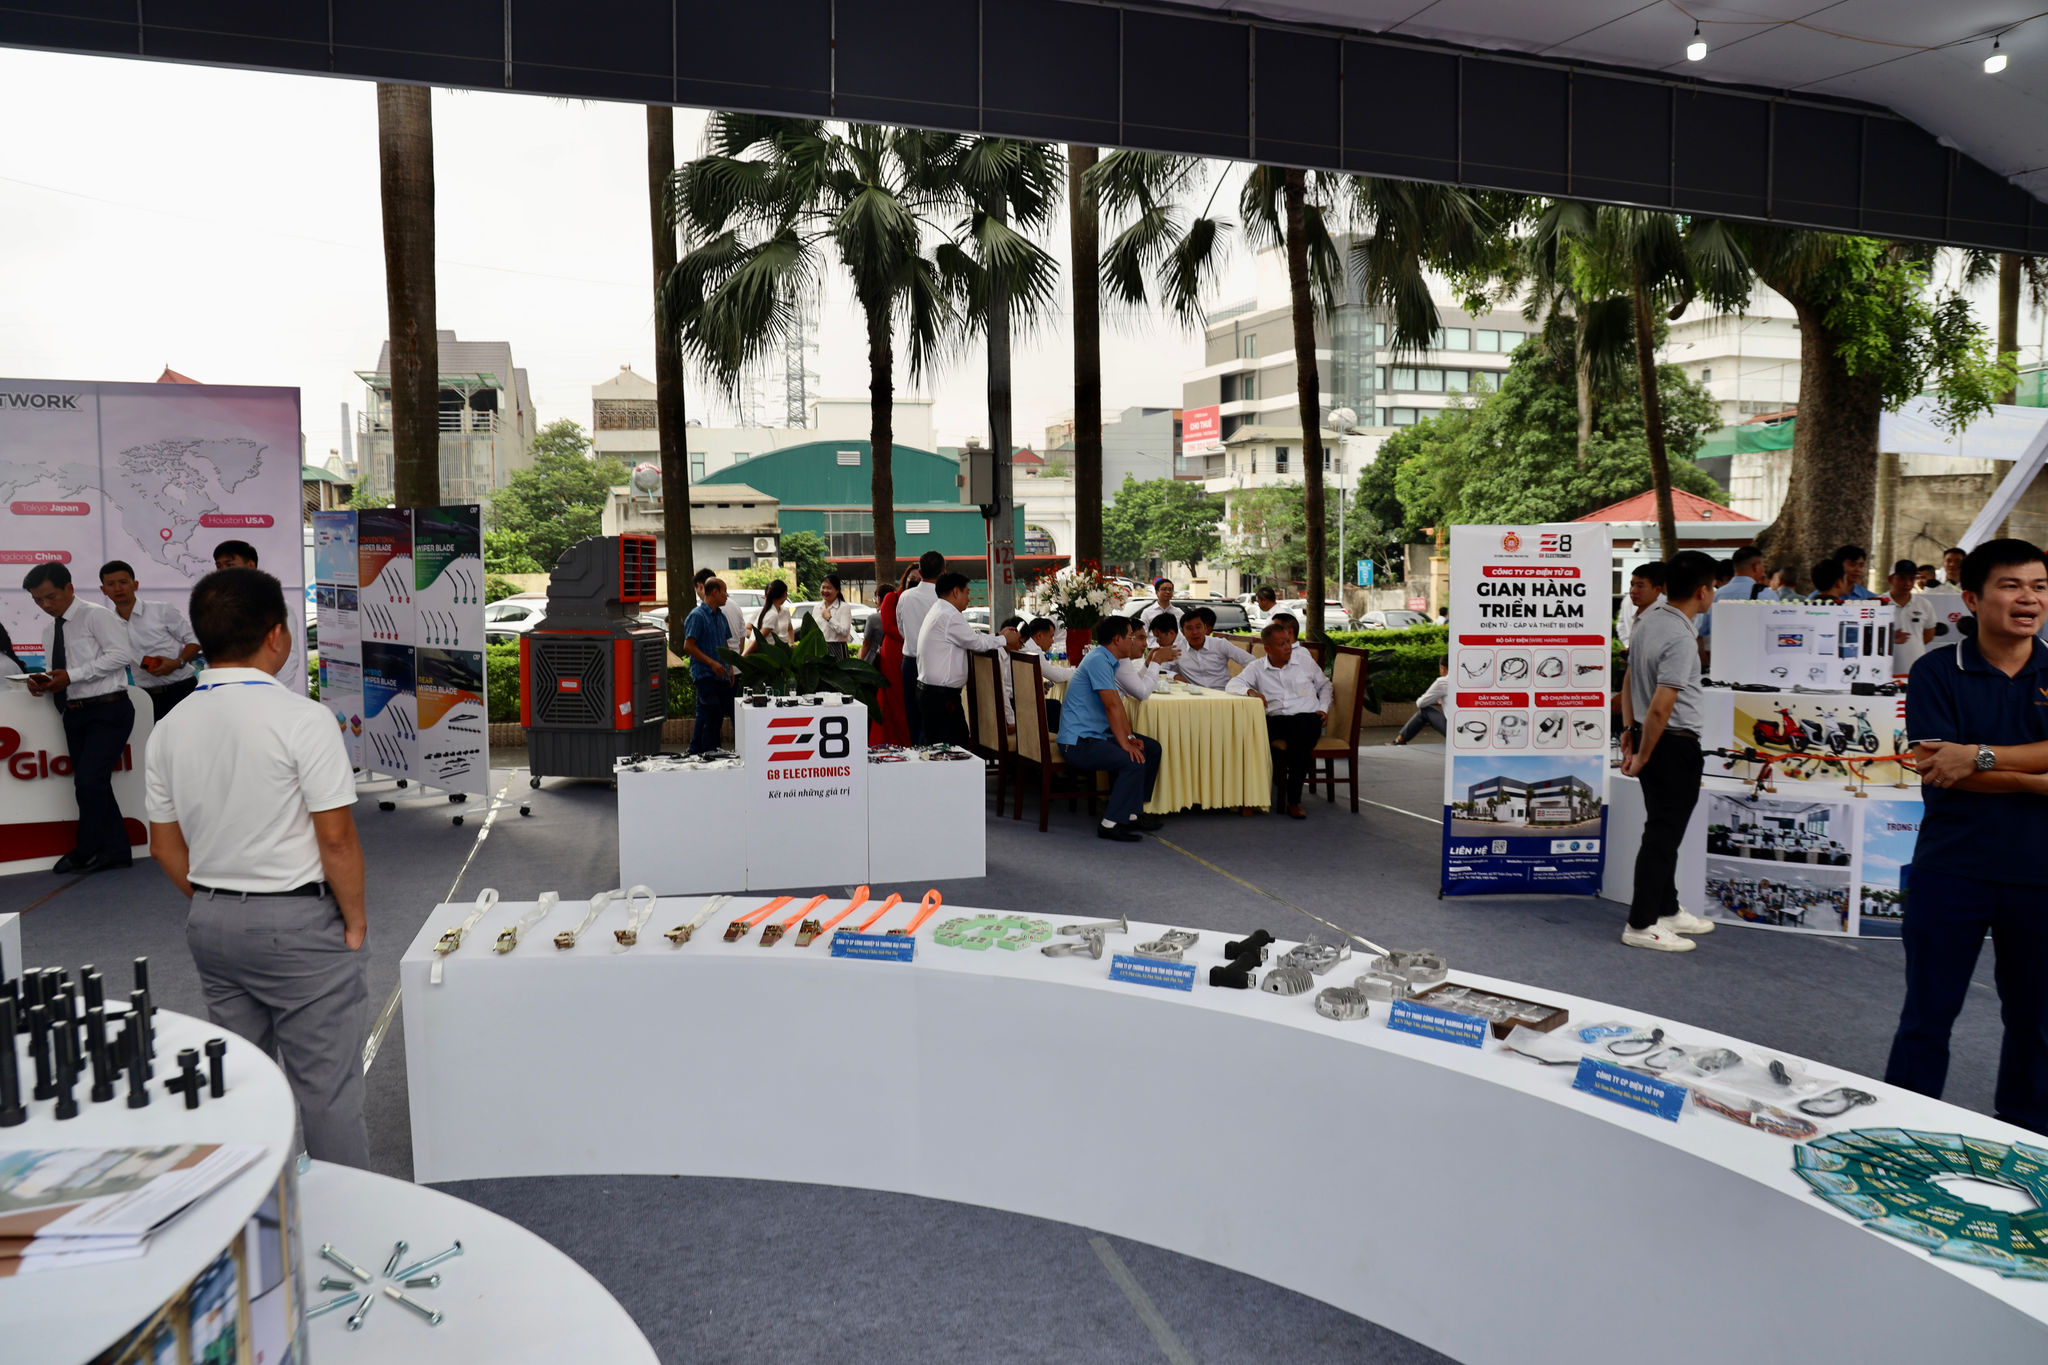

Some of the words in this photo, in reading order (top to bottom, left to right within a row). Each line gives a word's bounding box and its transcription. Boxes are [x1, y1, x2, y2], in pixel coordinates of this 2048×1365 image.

[22, 503, 48, 513] Tokyo
[50, 503, 79, 514] Japan
[208, 516, 244, 525] Houston
[245, 516, 265, 525] USA
[416, 544, 434, 552] WIPER
[435, 543, 455, 551] BLADE
[35, 552, 62, 561] China
[1477, 583, 1525, 597] GIAN
[1532, 579, 1586, 597] HÀNG
[1543, 600, 1583, 617] LÃM
[380, 678, 397, 687] BLADE
[418, 684, 438, 693] WIPER
[438, 686, 458, 695] BLADE
[9, 744, 132, 780] Glol
[767, 769, 780, 780] G8
[783, 765, 851, 779] ELECTRONICS
[768, 790, 781, 799] Kết
[783, 788, 796, 798] nối
[798, 787, 824, 798] những
[825, 786, 838, 797] giá
[840, 786, 850, 796] trị
[1886, 823, 1912, 832] TRONG
[1450, 845, 1472, 855] LIÊN
[1474, 846, 1488, 856] HỆ
[1596, 1070, 1612, 1082] CÔNG
[1613, 1075, 1620, 1084] TY
[1620, 1078, 1628, 1087] CP
